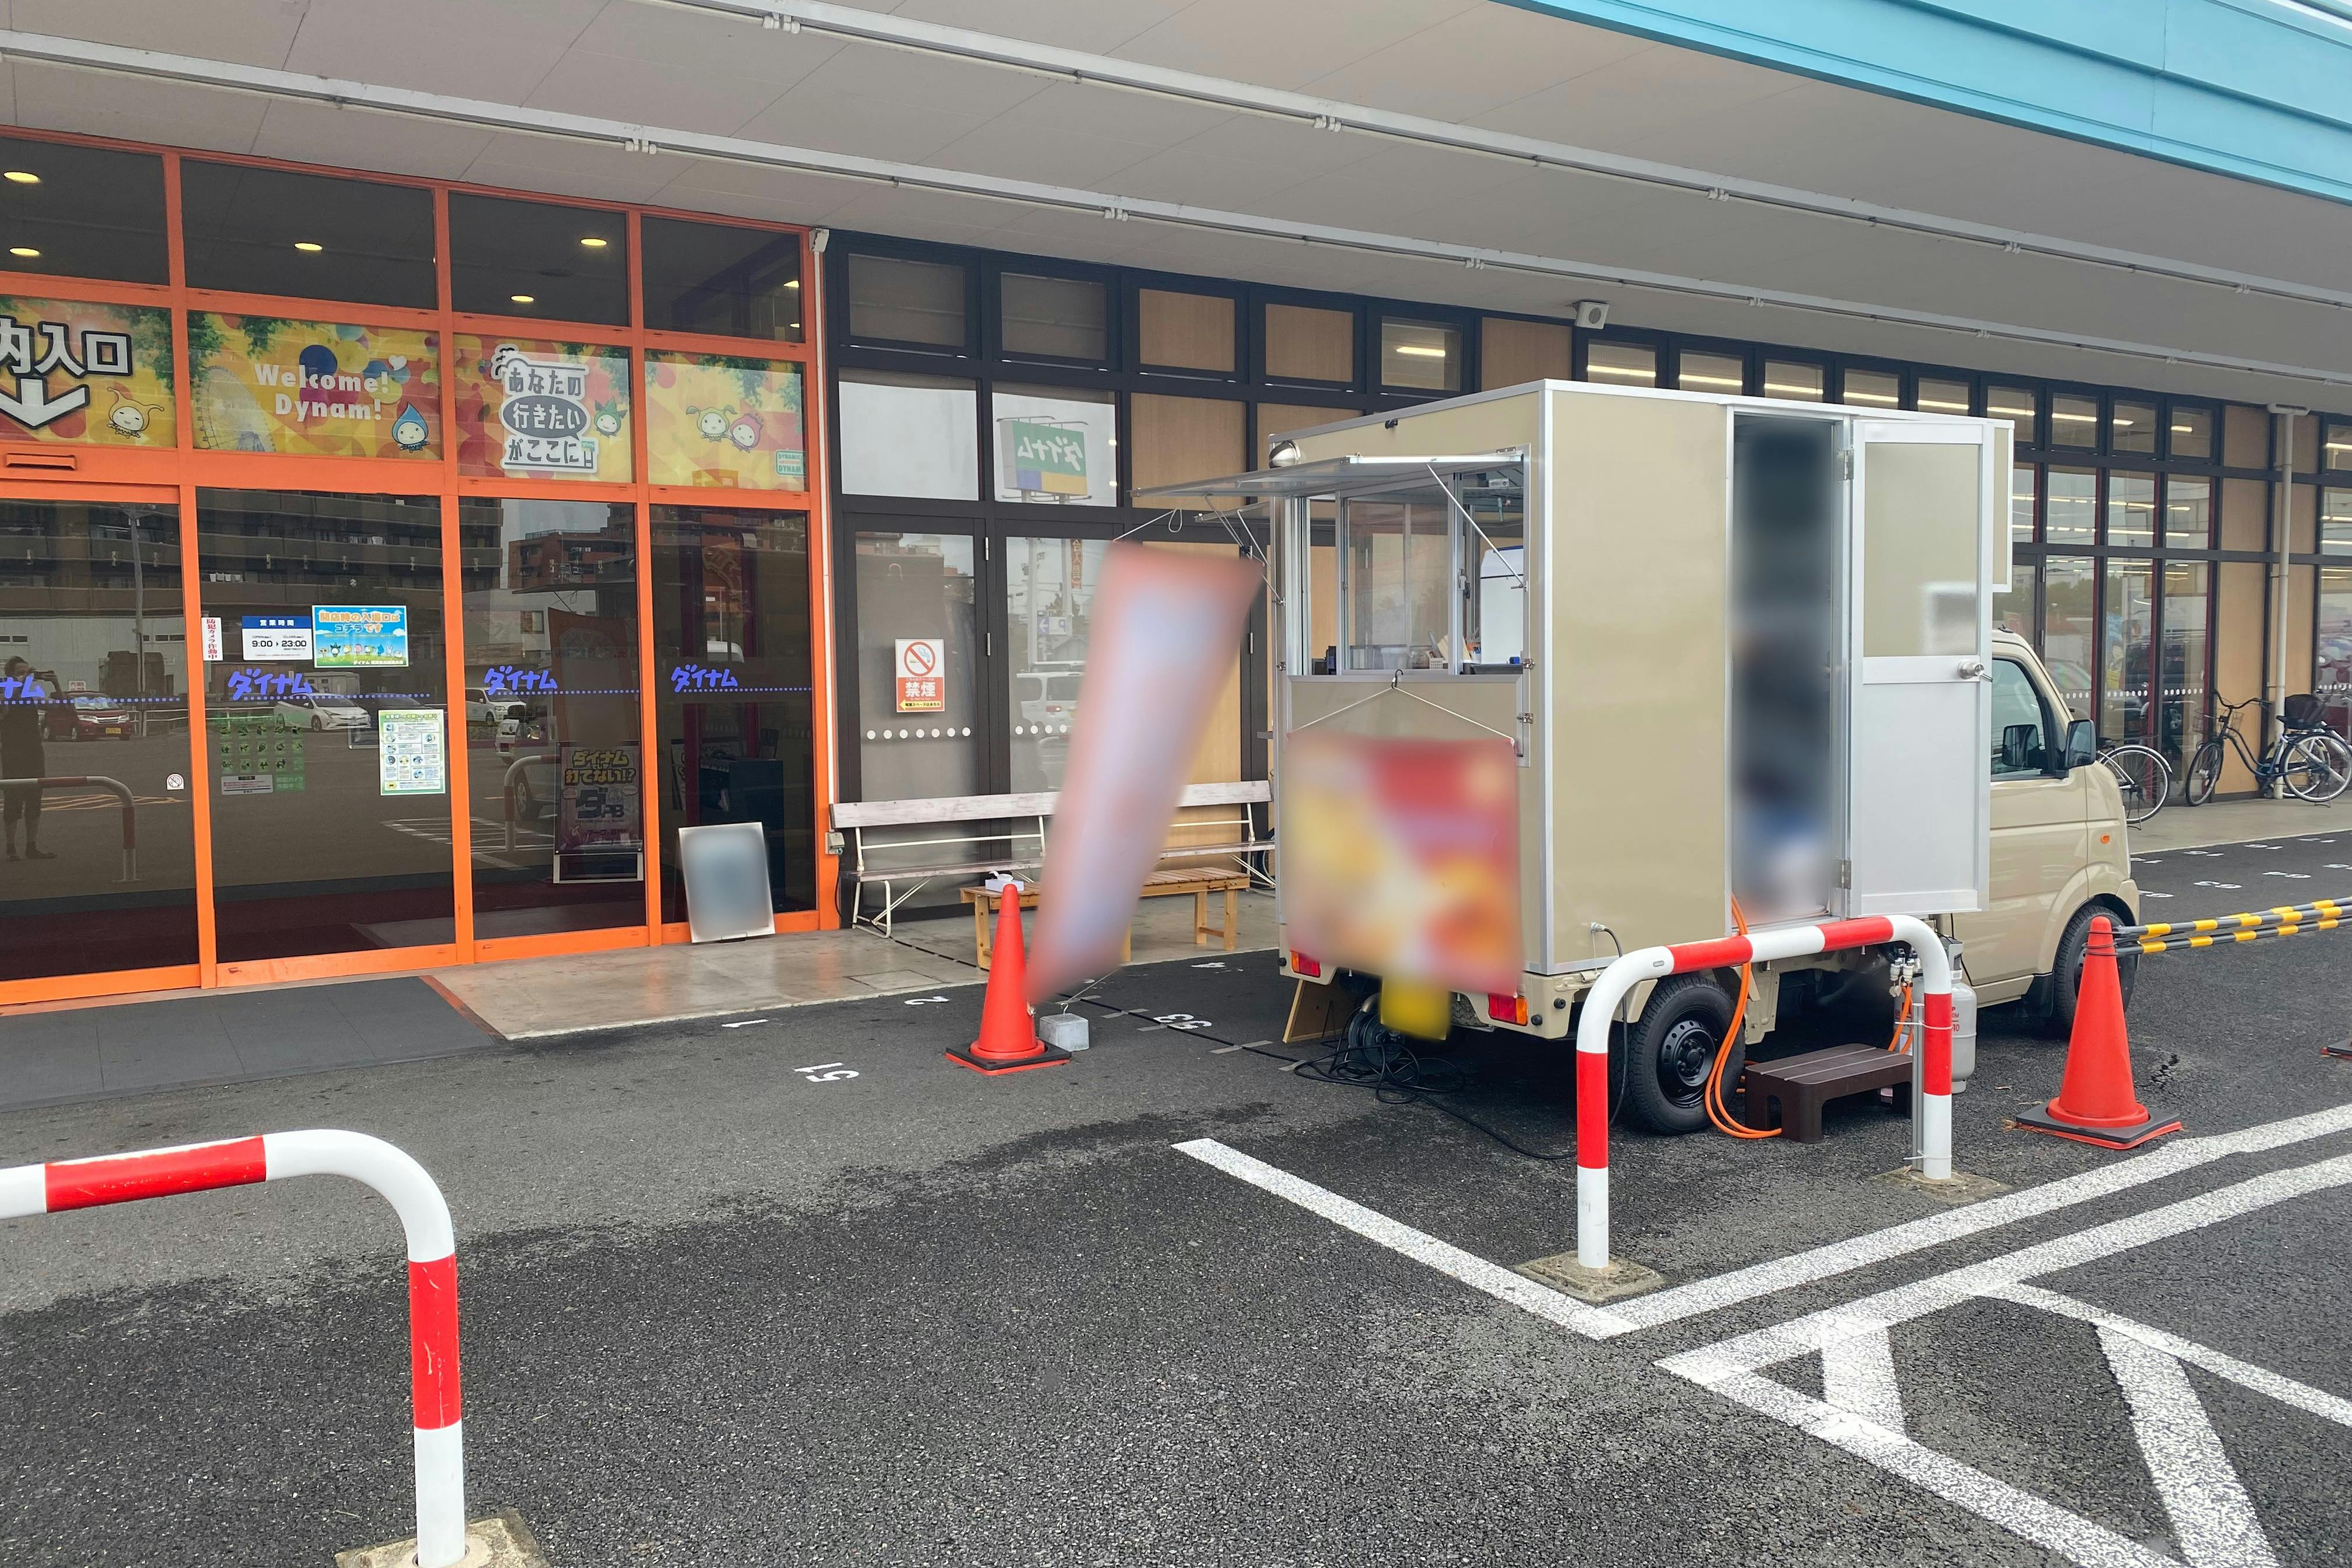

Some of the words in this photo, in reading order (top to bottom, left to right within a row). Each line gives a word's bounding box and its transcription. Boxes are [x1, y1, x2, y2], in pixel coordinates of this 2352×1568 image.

[254, 363, 388, 394] Welcome!
[509, 367, 581, 396] あなたの
[275, 393, 382, 422] Dynam!
[513, 402, 580, 430] 行きたい
[260, 619, 295, 627] 営業時間
[335, 624, 383, 633] コチラです
[0, 677, 45, 699] ナム
[228, 668, 313, 700] ダイナム
[484, 665, 558, 695] ダイナム
[671, 664, 738, 693] ダイナム
[905, 681, 936, 698] 禁煙
[573, 750, 629, 766] ダイナム
[565, 769, 636, 785] 打てない!?
[794, 1062, 860, 1083] 51
